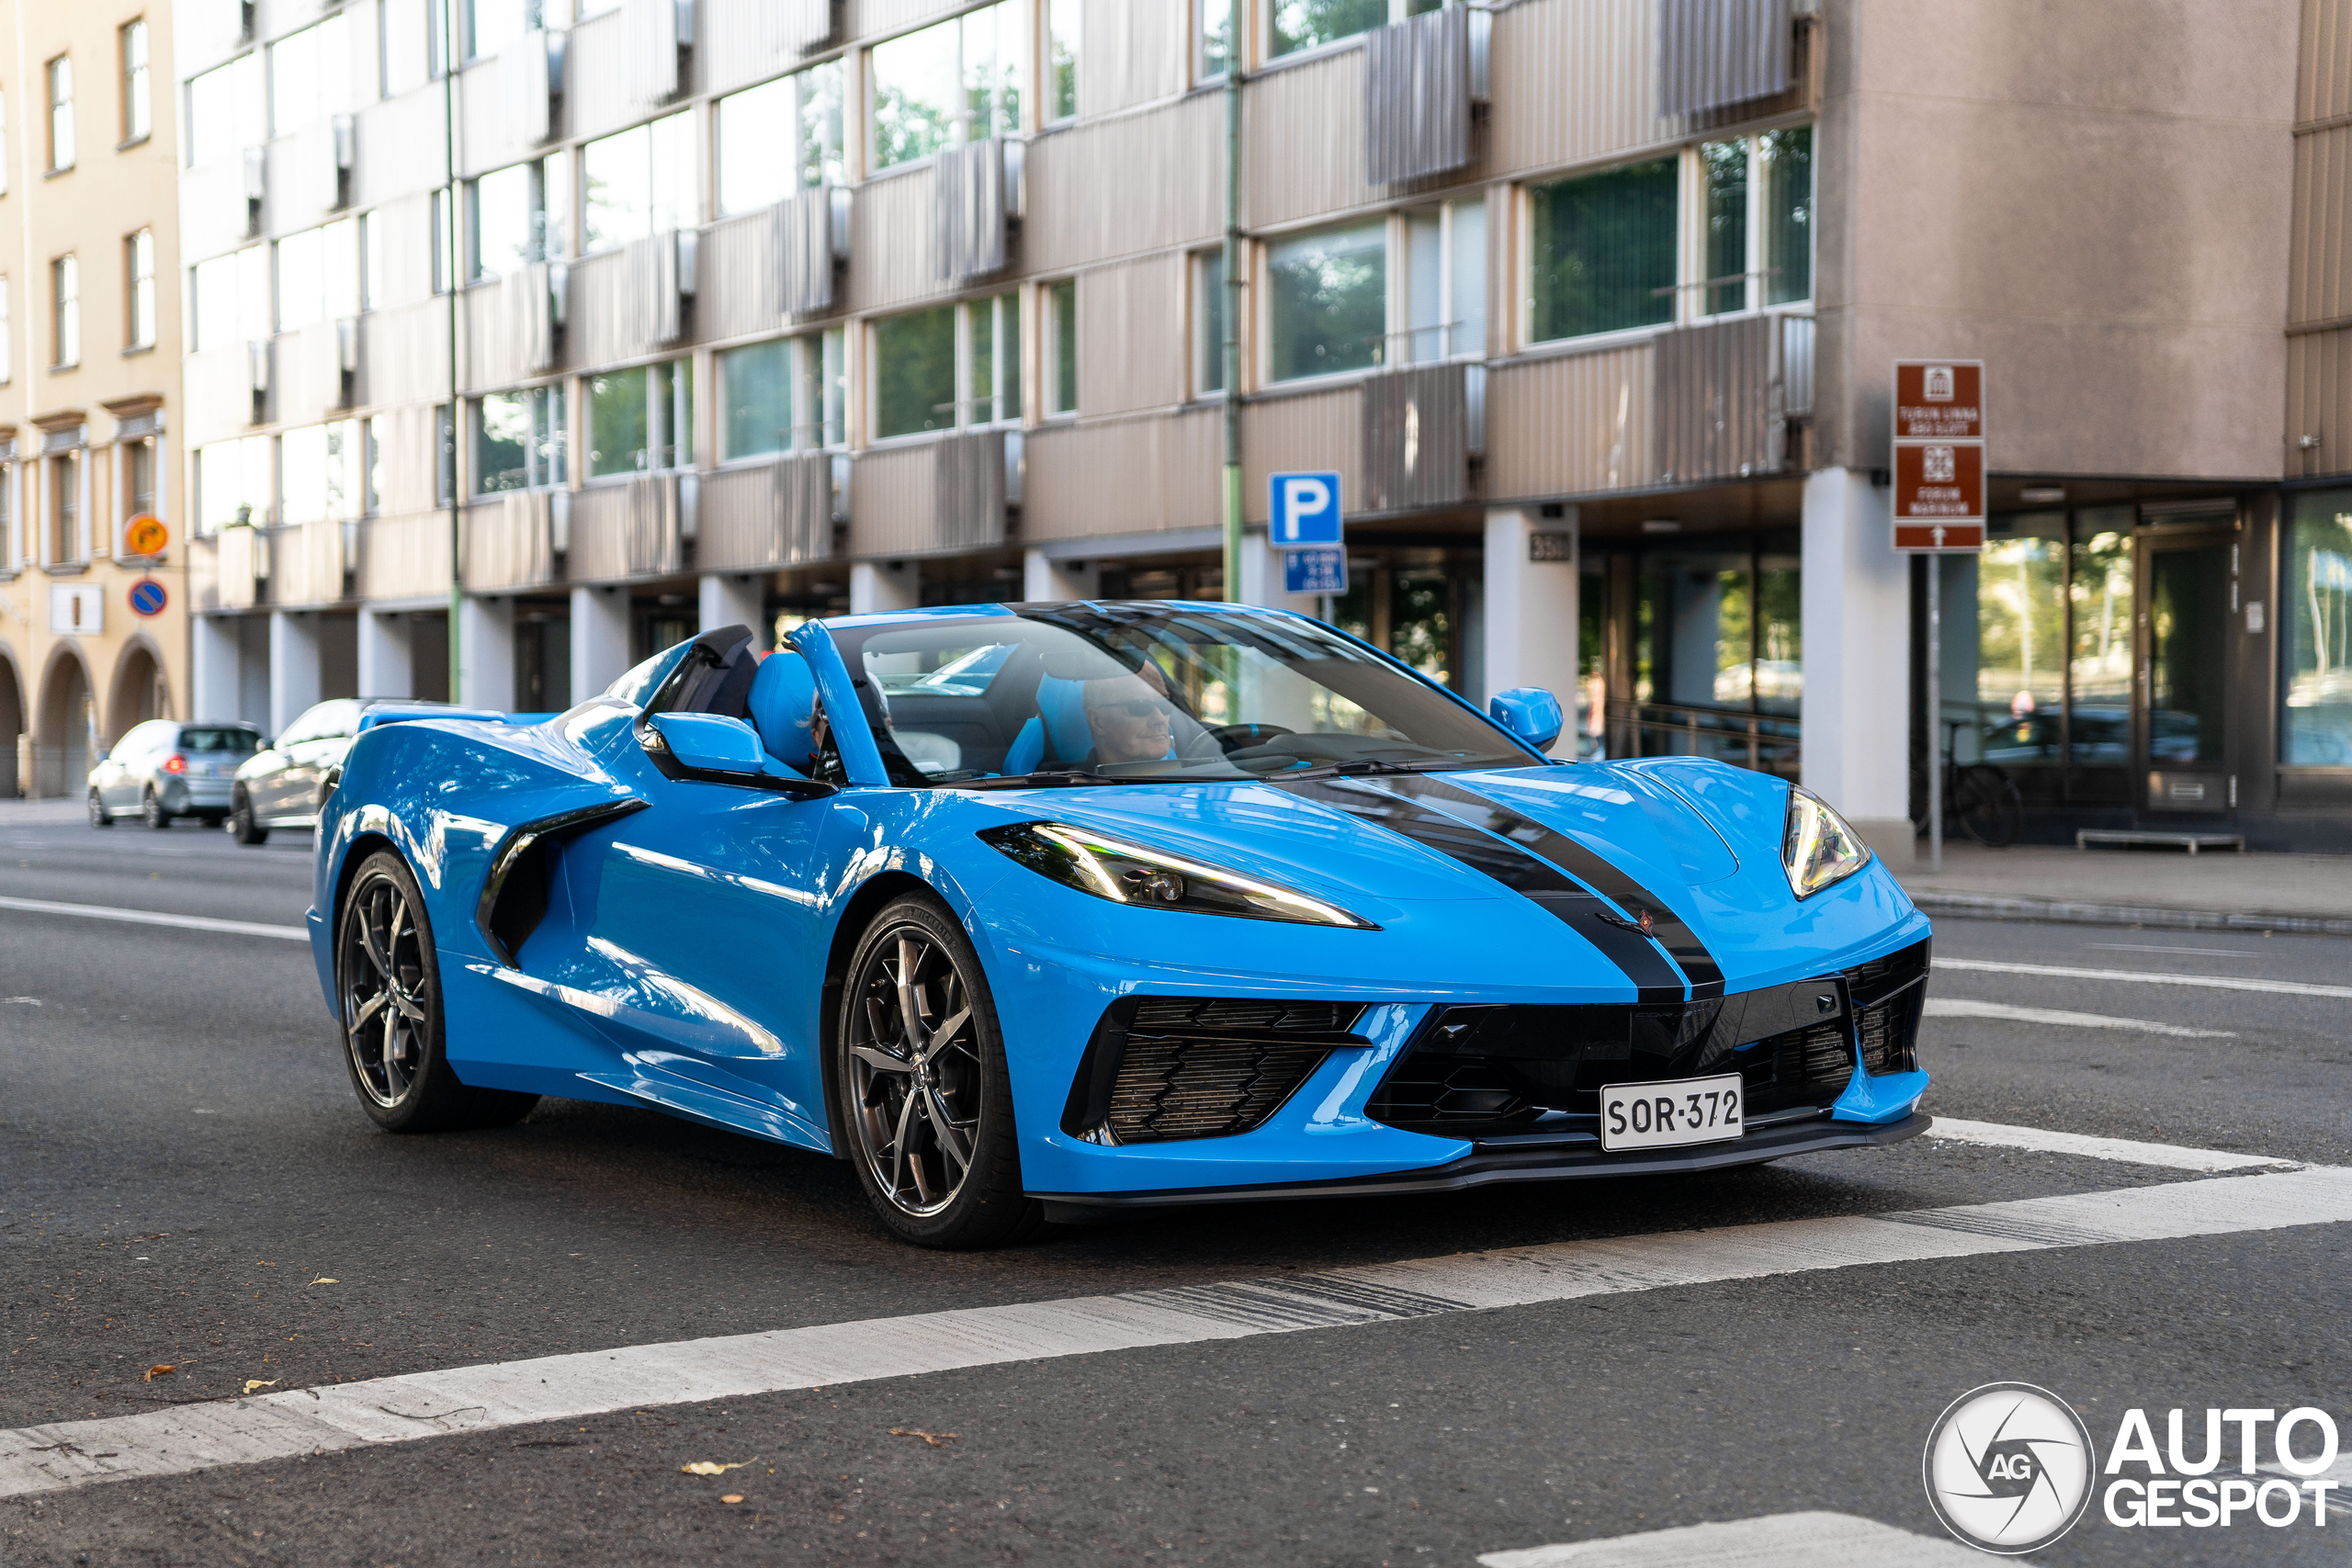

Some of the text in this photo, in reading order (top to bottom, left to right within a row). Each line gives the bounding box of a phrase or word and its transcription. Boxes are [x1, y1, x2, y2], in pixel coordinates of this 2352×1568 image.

[1283, 478, 1330, 540] P
[913, 908, 953, 942] MICHELIN
[1609, 1089, 1739, 1135] SOR-372
